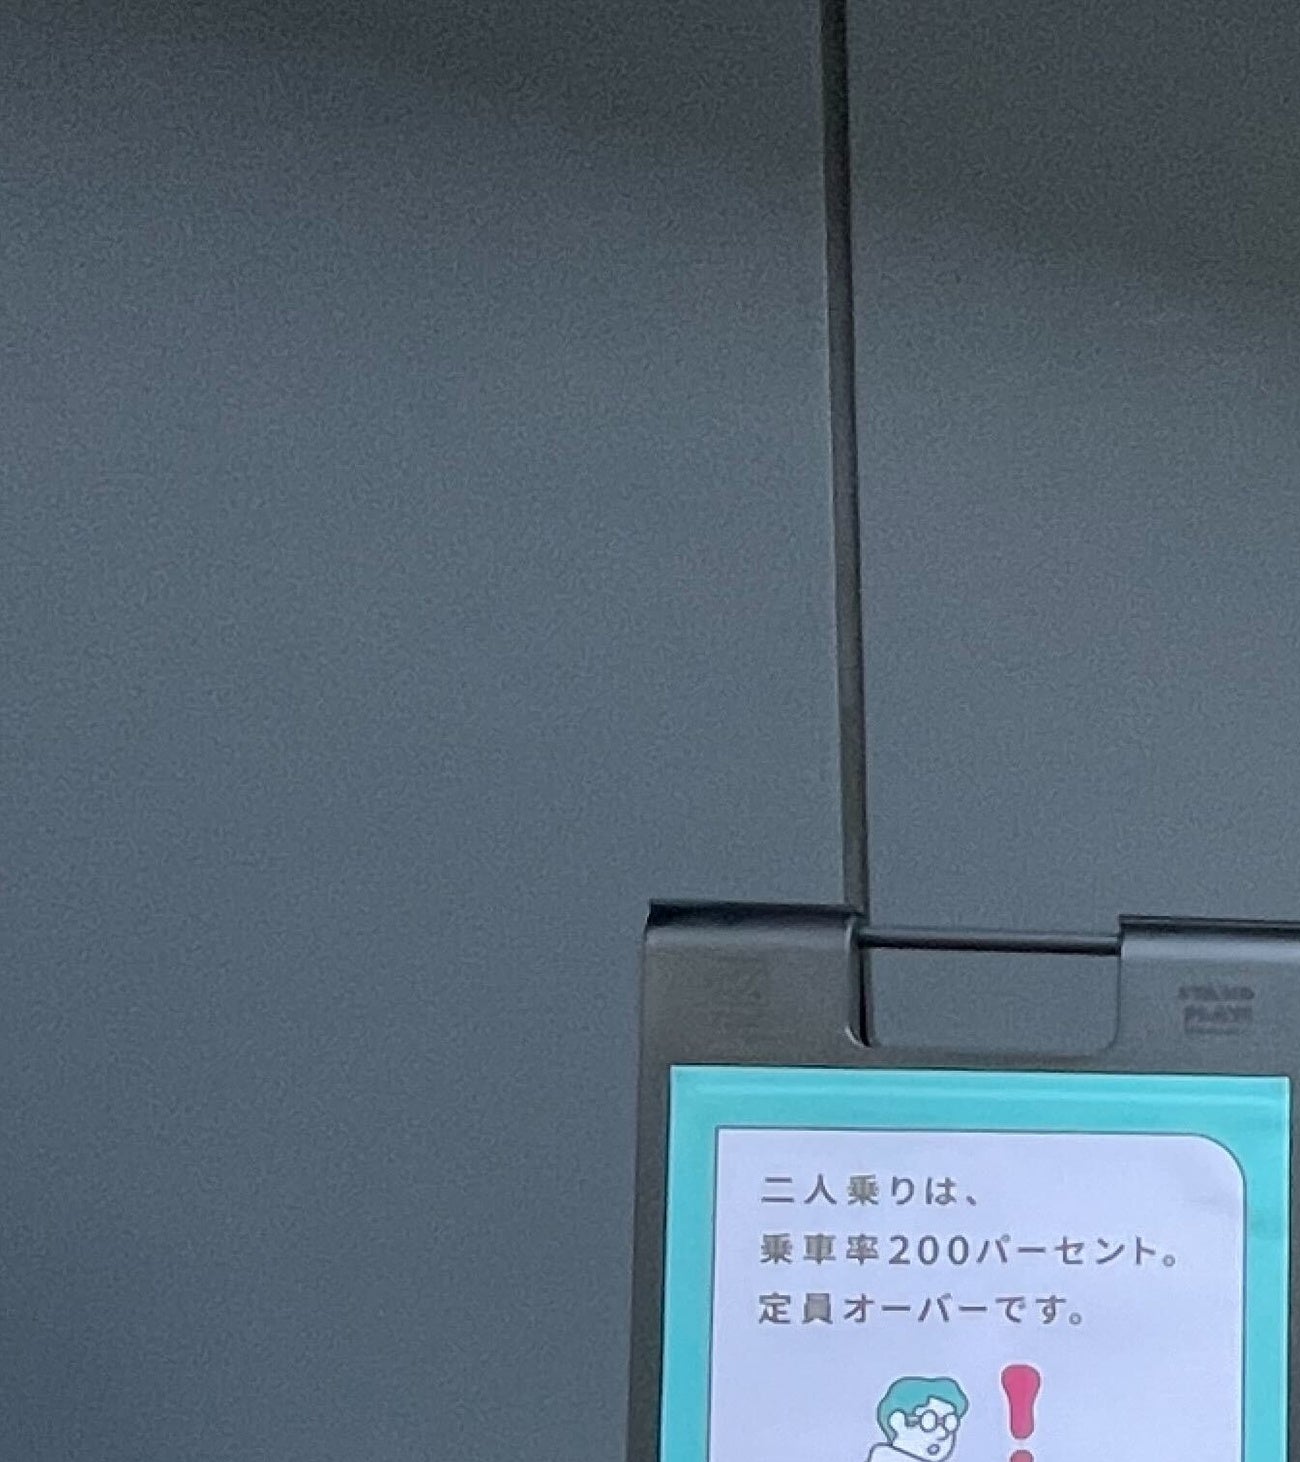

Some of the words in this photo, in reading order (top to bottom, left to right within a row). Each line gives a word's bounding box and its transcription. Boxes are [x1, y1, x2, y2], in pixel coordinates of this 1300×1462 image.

[759, 1173, 979, 1208] 二人乗りは、
[759, 1232, 1177, 1268] 乗車率200パーセント。
[757, 1292, 1083, 1326] 定員オーバーです。
